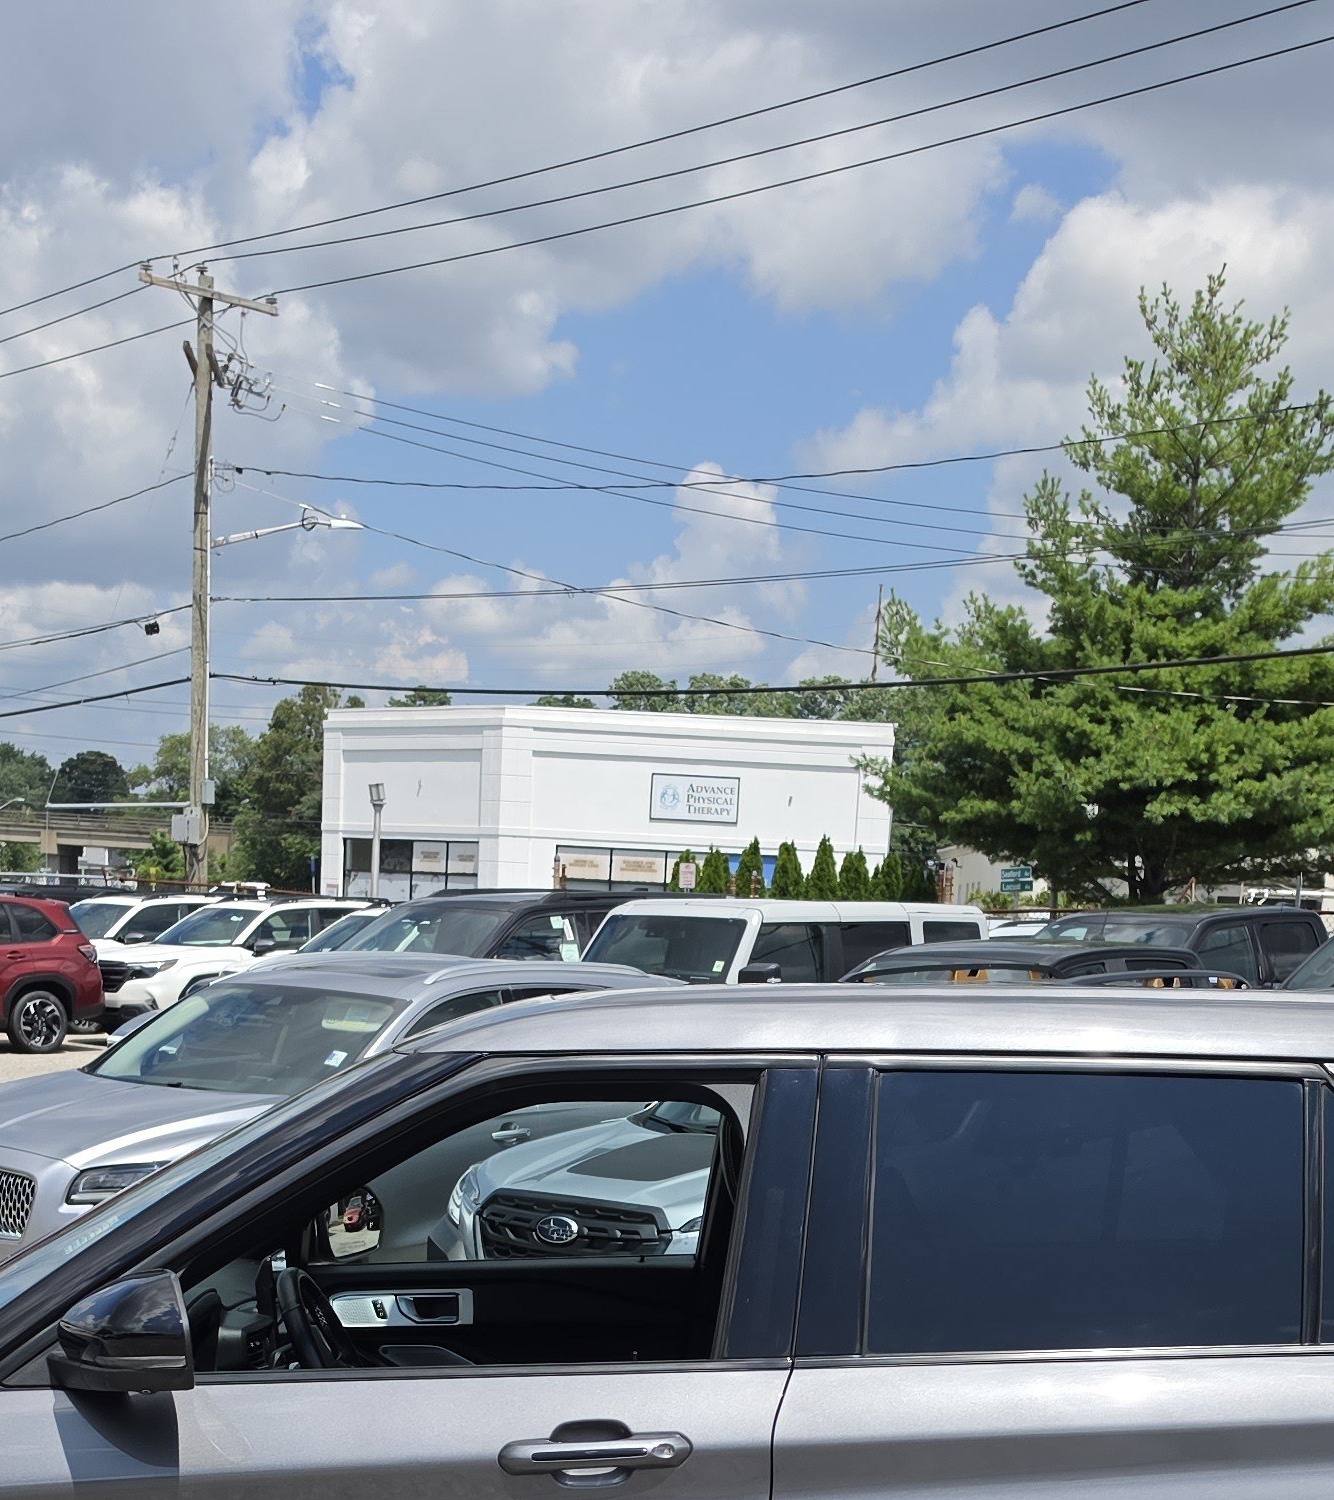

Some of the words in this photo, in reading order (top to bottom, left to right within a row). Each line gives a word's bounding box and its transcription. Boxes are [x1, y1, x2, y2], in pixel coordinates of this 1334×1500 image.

[686, 783, 736, 796] ADVANCE
[686, 793, 736, 806] PHYSICAL
[686, 804, 732, 816] THERAPY
